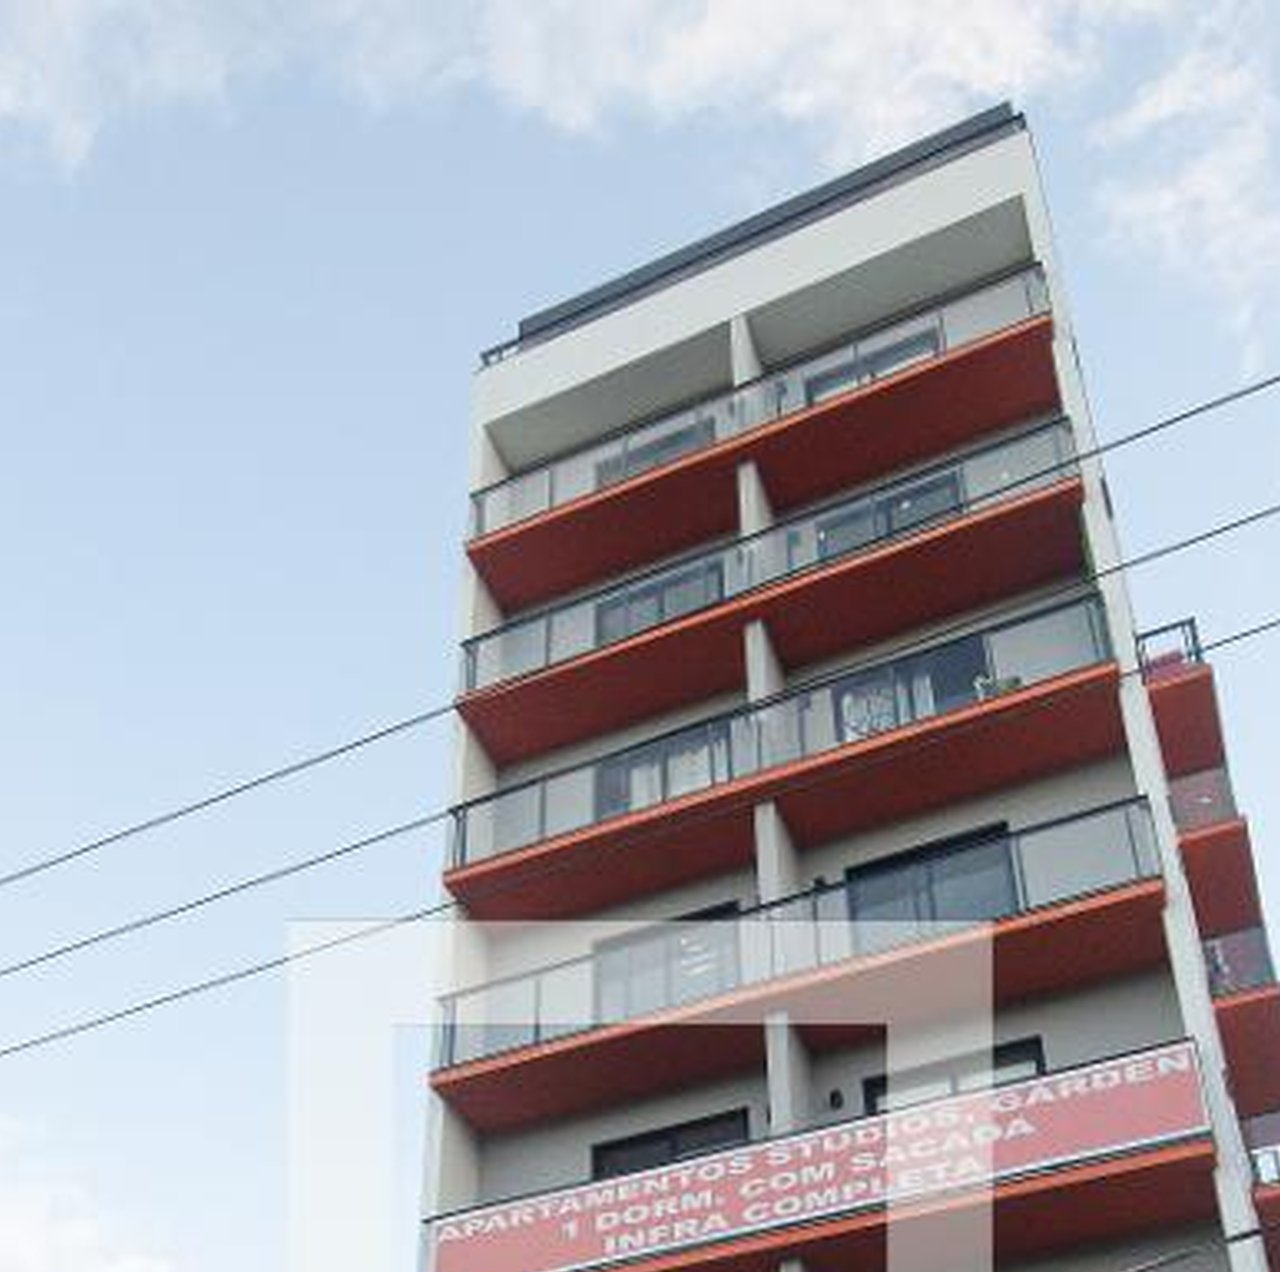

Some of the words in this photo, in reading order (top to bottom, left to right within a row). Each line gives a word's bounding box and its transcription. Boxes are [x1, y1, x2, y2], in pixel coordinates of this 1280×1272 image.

[437, 1153, 753, 1243] APARTAMENTOS
[992, 1050, 1190, 1113] GARDEN
[560, 1221, 578, 1240] 1
[739, 1164, 835, 1199] COM
[850, 1118, 1037, 1170] SACADA
[602, 1213, 731, 1255] INFRA
[741, 1156, 981, 1222] COMPLETA
